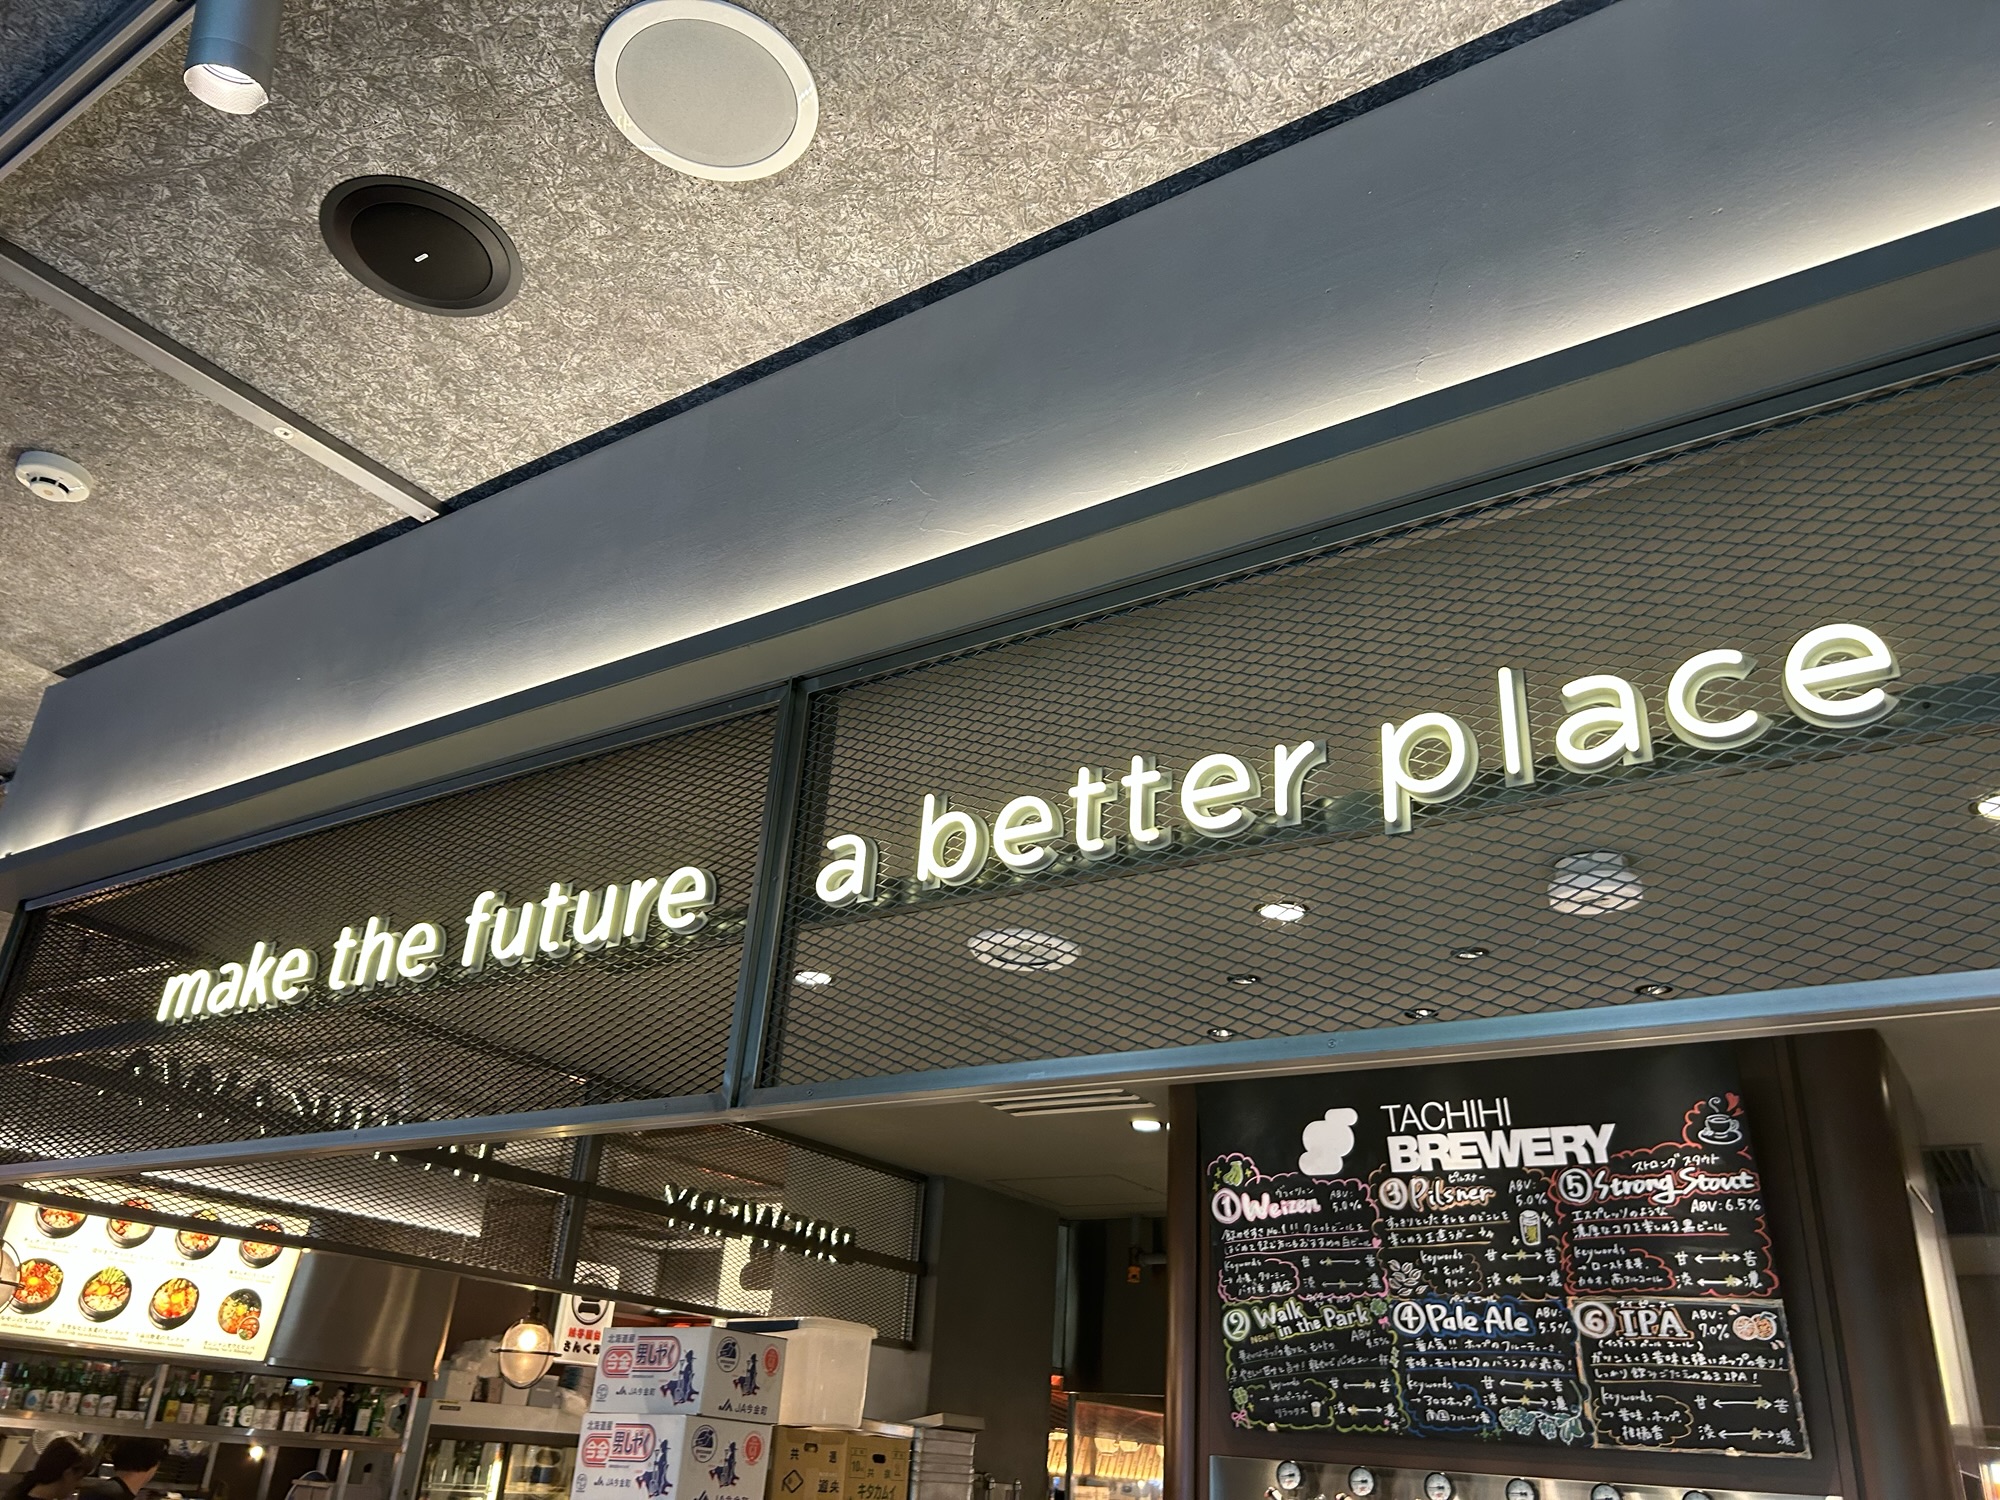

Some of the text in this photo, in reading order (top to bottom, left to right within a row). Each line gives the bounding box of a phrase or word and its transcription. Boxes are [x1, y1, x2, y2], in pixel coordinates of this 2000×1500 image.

[156, 622, 1895, 1023] make the future a better place
[1380, 1097, 1511, 1133] TACHIHI
[1387, 1123, 1615, 1174] BREWERY
[1632, 1153, 1720, 1173] ストロング スタウト
[1448, 1171, 1485, 1184] ピルスナー
[1508, 1178, 1536, 1193] ABV:
[1593, 1170, 1683, 1205] Strong
[1677, 1167, 1756, 1197] Stout
[1409, 1176, 1496, 1212] Pilsner
[1515, 1192, 1548, 1206] 5.0%
[1240, 1192, 1321, 1222] Weizen
[1332, 1200, 1362, 1213] 5.0%
[1571, 1206, 1669, 1222] エスプレッソのような
[1691, 1198, 1761, 1214] ABV: 6.5%
[1484, 1248, 1557, 1263] 甘 苦
[1675, 1251, 1758, 1267] 甘 苦
[1676, 1270, 1763, 1289] 淡 濃
[1253, 1298, 1303, 1329] Walk
[1278, 1303, 1370, 1338] in the Park
[1425, 1304, 1479, 1333] Pale
[1484, 1306, 1530, 1334] Ale
[1535, 1306, 1563, 1319] ABV:
[1691, 1310, 1724, 1321] ABV:
[1538, 1321, 1572, 1334] 5.5%
[1618, 1308, 1690, 1339] IPA
[1698, 1323, 1730, 1340] 7.0%
[1365, 1337, 1390, 1349] 4.5%
[1480, 1375, 1564, 1393] 甘 苦
[1483, 1393, 1568, 1412] 淡 濃
[1601, 1387, 1653, 1407] keywords
[1694, 1395, 1789, 1414] 甘 苦
[734, 1403, 768, 1416] JA今金町
[1697, 1424, 1796, 1447] 淡 濃
